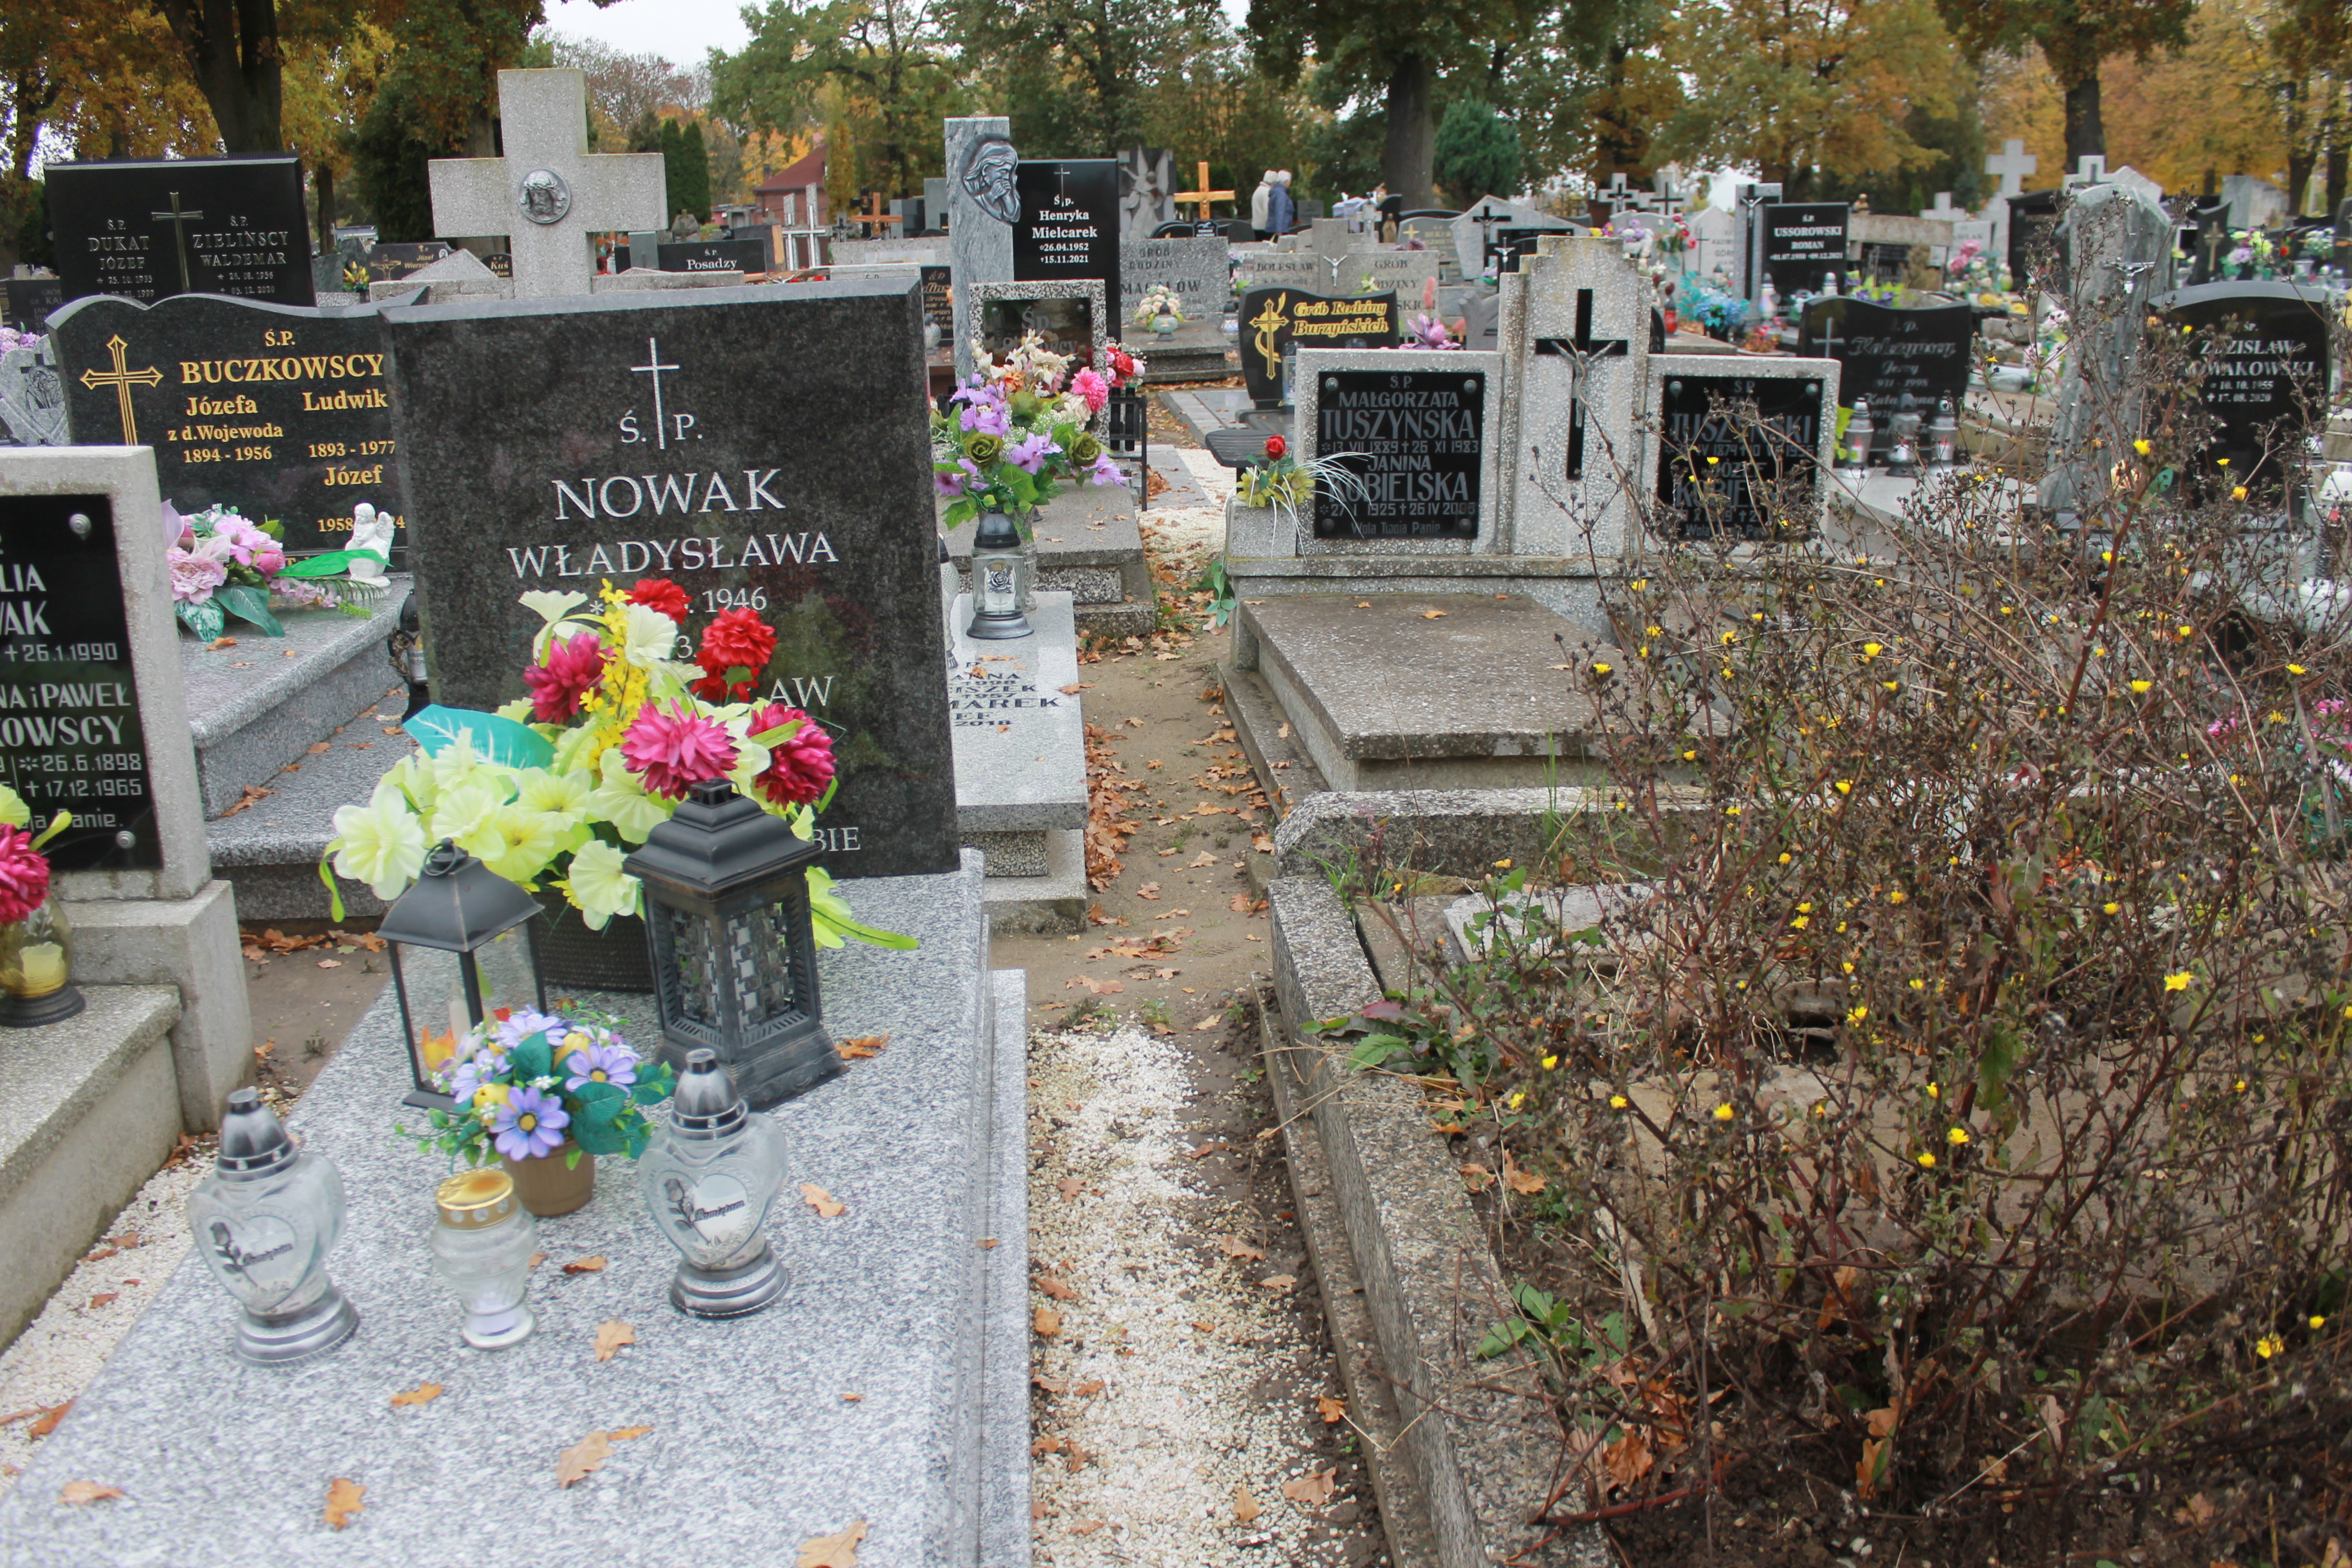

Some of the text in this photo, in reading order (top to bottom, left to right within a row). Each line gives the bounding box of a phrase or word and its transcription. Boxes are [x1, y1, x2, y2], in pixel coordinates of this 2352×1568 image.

[1039, 210, 1089, 222] Henryka
[1032, 226, 1098, 238] Mielcarek
[1774, 226, 1842, 237] USSOROWSKI
[88, 236, 149, 251] DUKAT
[1044, 243, 1089, 252] 26.04.1952
[1791, 241, 1825, 250] ROMAN
[100, 257, 144, 269] JÓZEF
[200, 252, 286, 266] WALDEMAR
[491, 261, 508, 270] Kuś
[687, 258, 737, 270] Posadzy
[1045, 255, 1088, 264] 15.11.2021
[1375, 256, 1408, 269] GRÓB
[1294, 300, 1387, 317] Grób Rodziny
[1292, 317, 1389, 337] Burzyńskich
[180, 353, 384, 384] BUCZKOWSCY
[187, 394, 257, 417] Józefa
[303, 389, 388, 411] Ludwik
[1339, 391, 1459, 407] MAŁGORZATA
[1865, 393, 1935, 405] Katana
[1322, 410, 1476, 439] TUSZYŃSKA
[309, 443, 345, 458] 1893
[360, 440, 395, 455] 1977
[1349, 442, 1364, 453] VII
[1412, 441, 1428, 453] 26
[1435, 441, 1446, 453] XI
[1452, 441, 1479, 453] 1983
[184, 449, 221, 464] 1894
[236, 447, 272, 461] 1956
[1368, 455, 1431, 471] JANINA
[324, 465, 383, 486] Józef
[551, 468, 786, 521] NOWAK
[1329, 472, 1468, 502] KOBIELSKA
[1368, 503, 1396, 516] 1925
[1409, 503, 1425, 515] 26
[318, 518, 353, 532] 1958
[1412, 520, 1440, 533] Panie
[507, 532, 839, 579] WŁADYSŁAWA
[702, 586, 768, 613] 1946
[0, 601, 52, 635] AK
[40, 682, 131, 708] PAWEŁ
[0, 715, 123, 747] OWSCY
[41, 753, 142, 771] 26.6.1898
[45, 778, 143, 797] 17.12.1965
